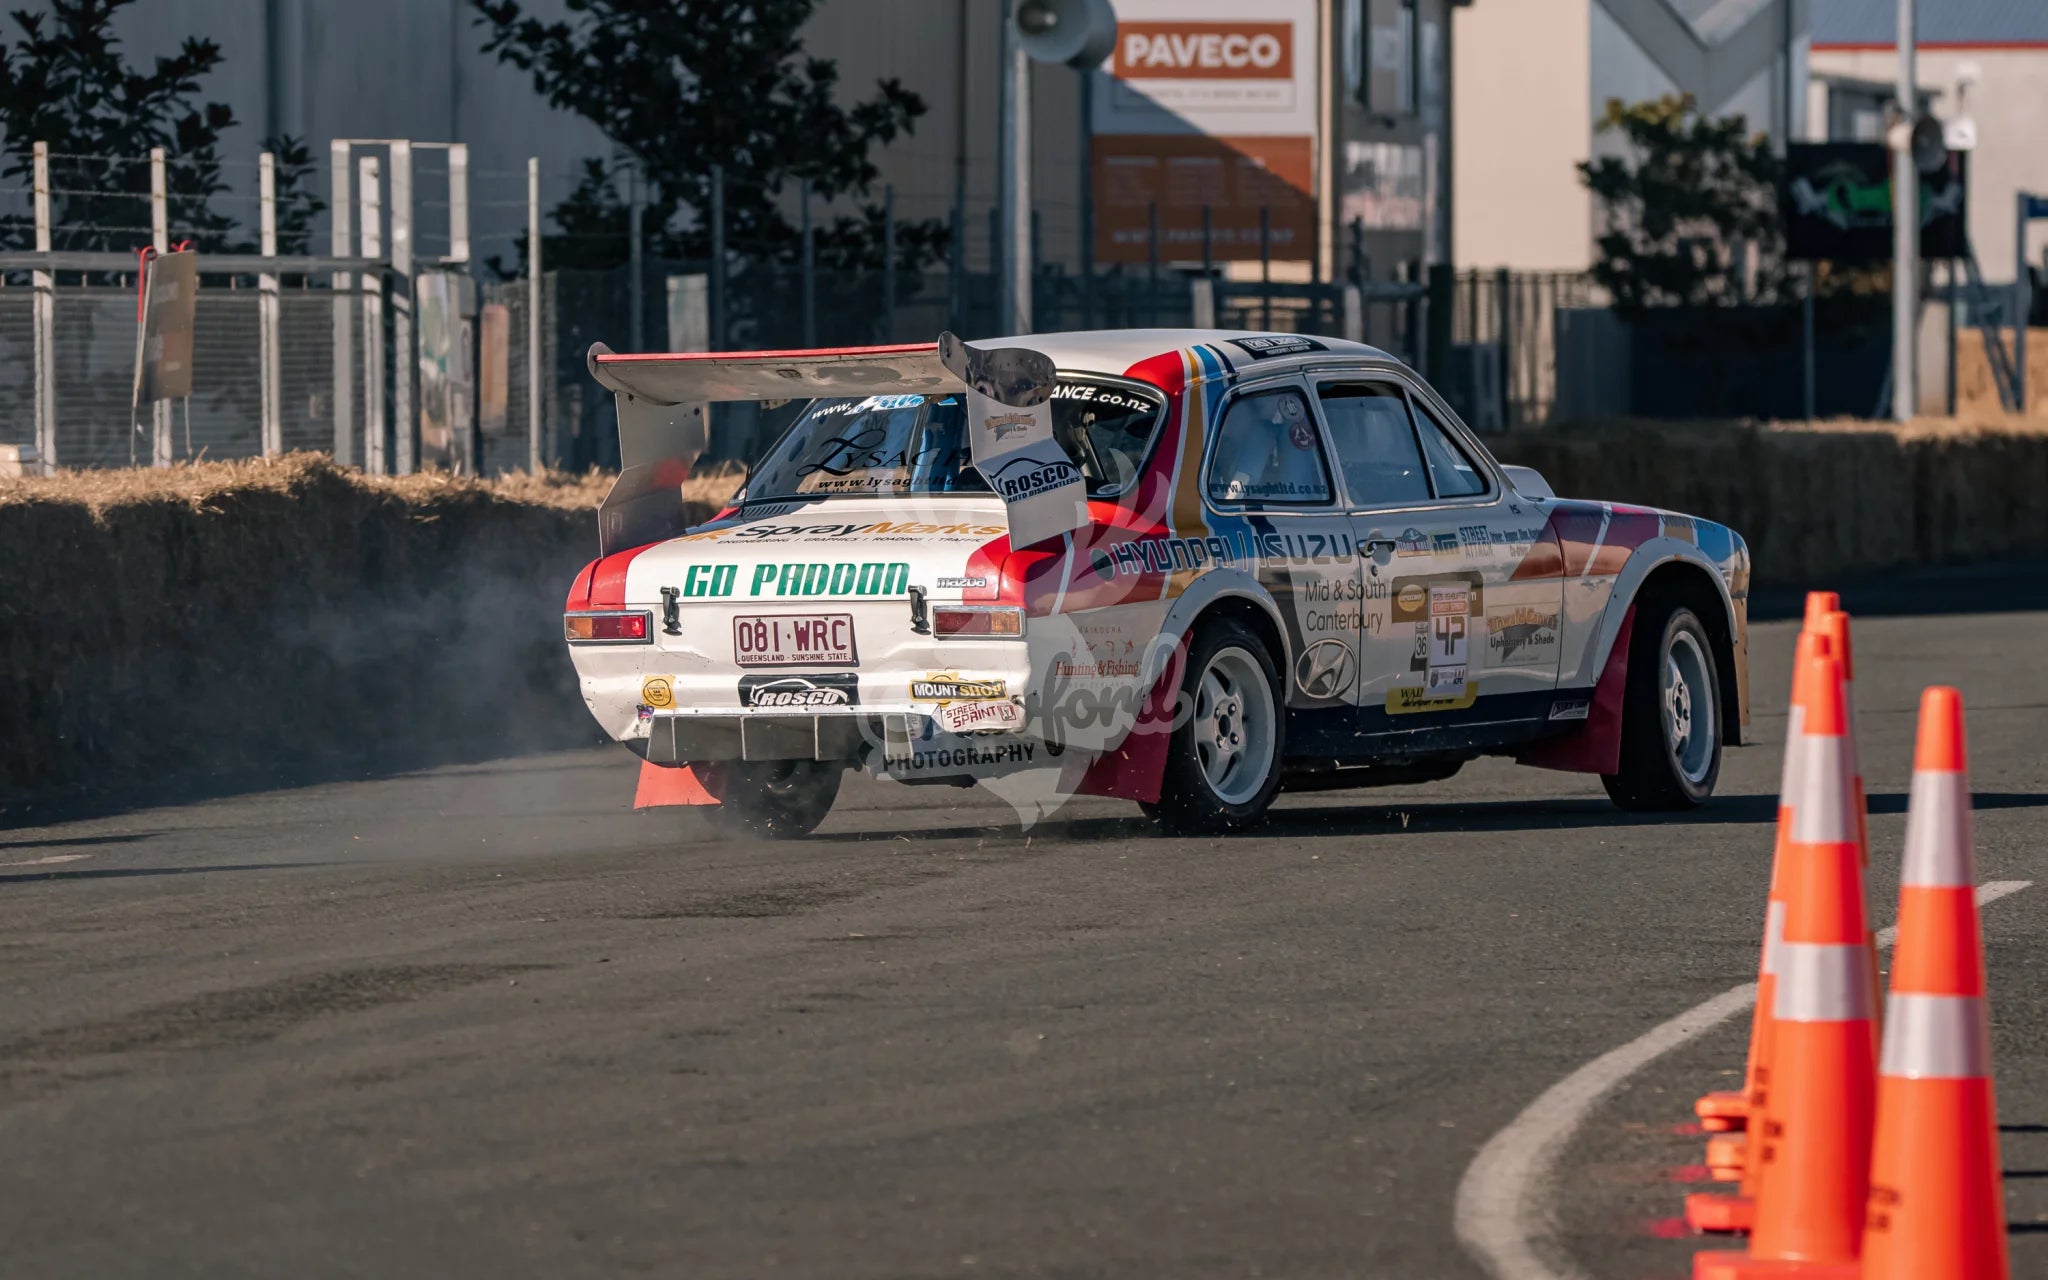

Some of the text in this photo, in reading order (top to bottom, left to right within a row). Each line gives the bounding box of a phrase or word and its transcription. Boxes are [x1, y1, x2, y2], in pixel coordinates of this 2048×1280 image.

[1124, 34, 1281, 68] PAVECO
[1004, 465, 1069, 497] ROSCO
[1007, 476, 1080, 504] AUTO DISMANTLERS
[1459, 525, 1490, 542] STREET
[1110, 533, 1354, 576] HYUNDAI ISUZU
[683, 562, 911, 597] GO PADDON
[1305, 580, 1329, 602] Mid
[1333, 580, 1343, 600] &
[1347, 578, 1386, 600] South
[1306, 608, 1383, 634] Canterbury
[1416, 636, 1427, 656] 36
[742, 654, 784, 662] QUEENSLAND
[1056, 660, 1096, 679] Hunting
[1106, 658, 1139, 678] Fishing
[757, 691, 838, 705] ROSCO
[914, 684, 957, 697] MOUNT
[946, 703, 979, 719] STREET
[953, 706, 996, 728] SPRINT
